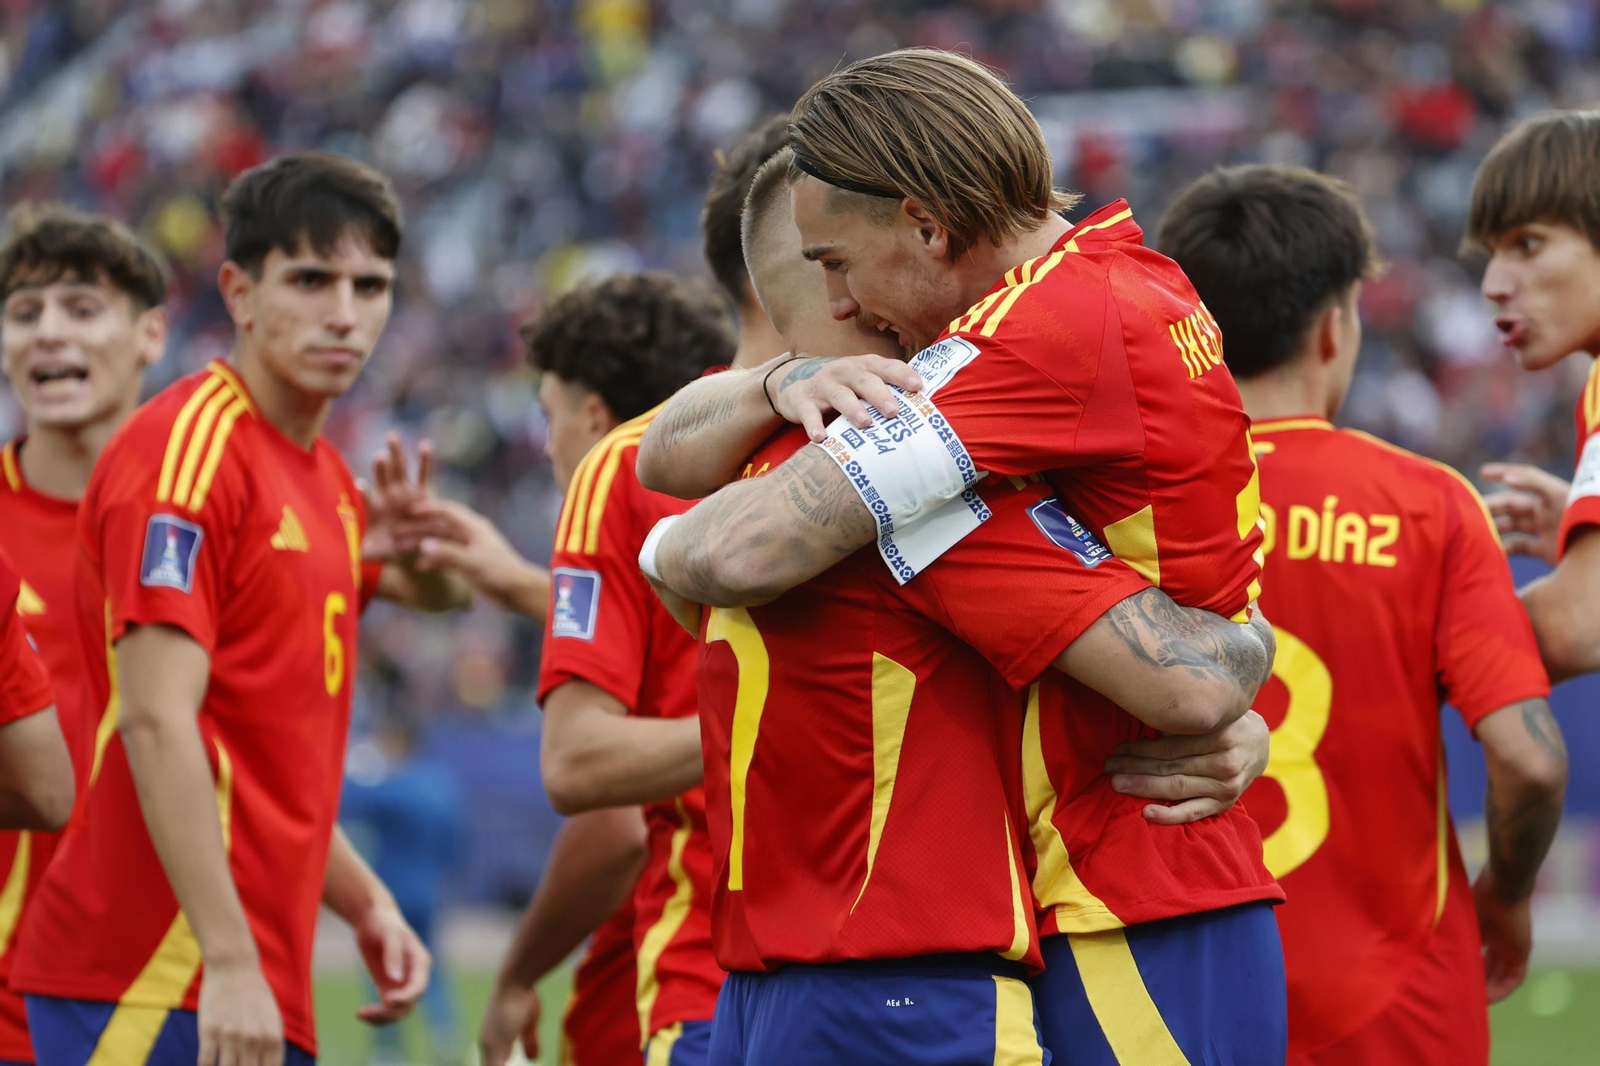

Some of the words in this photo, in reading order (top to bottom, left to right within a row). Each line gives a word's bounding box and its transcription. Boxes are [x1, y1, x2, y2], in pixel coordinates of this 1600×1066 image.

[842, 430, 862, 449] FIFA
[1287, 494, 1400, 568] DÍAZ
[323, 590, 347, 698] 6
